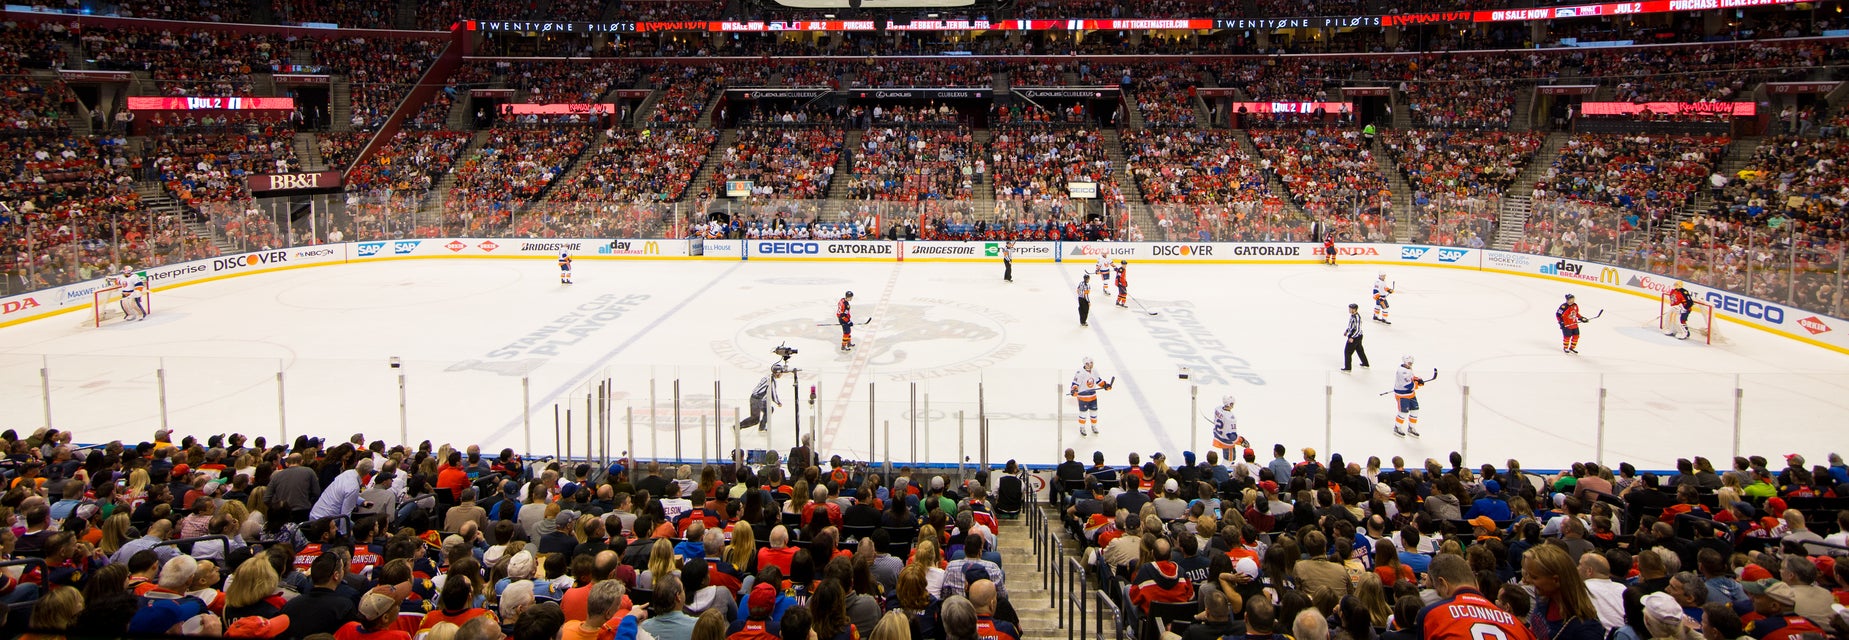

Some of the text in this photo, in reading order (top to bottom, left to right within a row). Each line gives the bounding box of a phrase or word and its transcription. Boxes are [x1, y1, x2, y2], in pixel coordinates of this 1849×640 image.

[1615, 3, 1641, 13] JUL 2
[1491, 9, 1548, 21] ON SALE NOW
[722, 22, 732, 30] ON
[748, 22, 764, 30] NOW
[808, 22, 827, 30] JUL 2
[843, 22, 873, 30] PURCHASE
[1113, 20, 1188, 28] OR AT TICKETMASTER.COM
[195, 98, 222, 109] JUL 2
[1277, 103, 1297, 112] JUL 2
[269, 173, 321, 190] BB&T
[358, 244, 381, 255] SAP
[395, 242, 418, 253] SAP
[598, 240, 631, 254] all day
[759, 243, 819, 254] GEICO
[828, 244, 892, 254] GATORADE
[912, 246, 975, 254] BRIDGESTONE
[1153, 246, 1213, 256] DISCOVER
[1234, 246, 1299, 256] GATORADE
[1402, 247, 1425, 259] SAP
[1439, 249, 1462, 261] SAP
[213, 251, 288, 271] DISCOVER
[1539, 260, 1582, 275] all day
[1559, 271, 1598, 282] BREAKFAST
[2, 297, 40, 314] DA
[1705, 292, 1784, 325] GEICO
[527, 293, 653, 357] PLAYOFFS
[1448, 605, 1515, 625] OCONNOR
